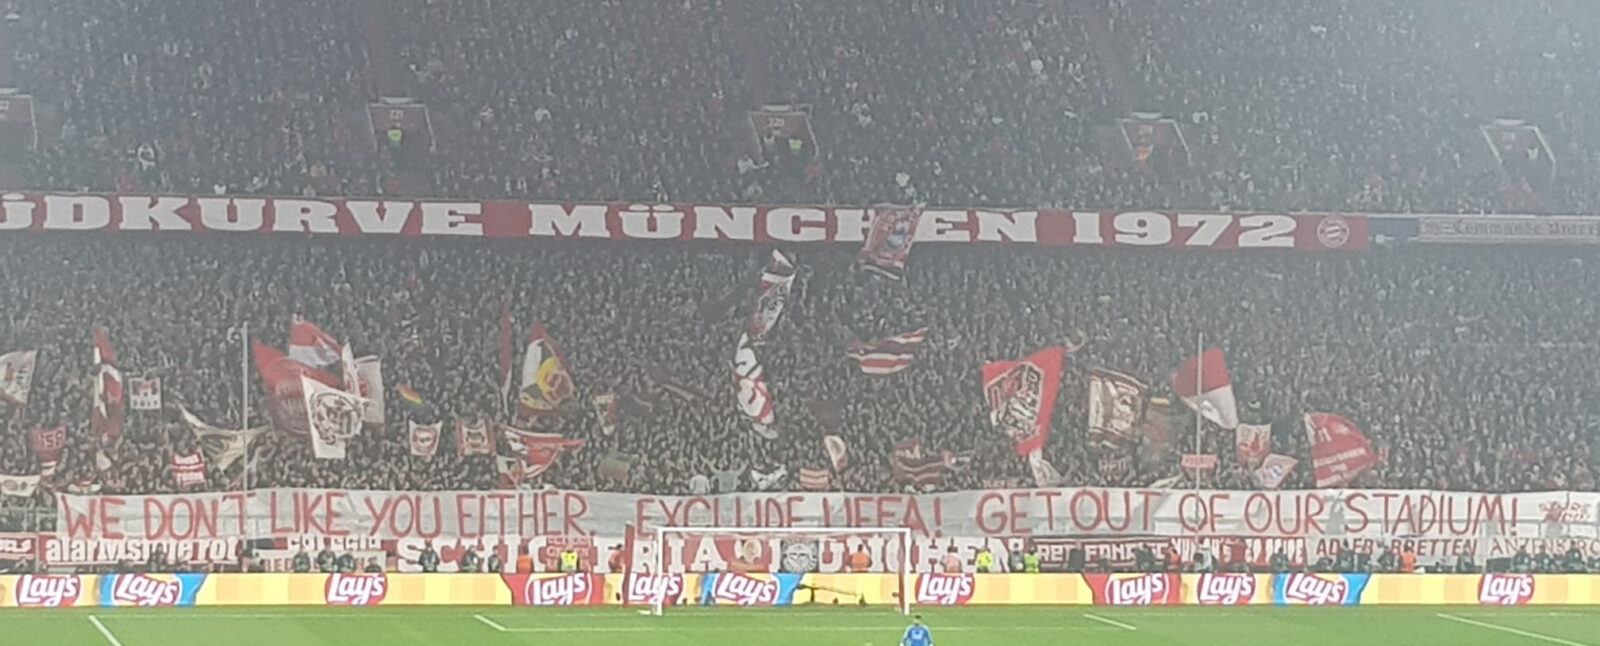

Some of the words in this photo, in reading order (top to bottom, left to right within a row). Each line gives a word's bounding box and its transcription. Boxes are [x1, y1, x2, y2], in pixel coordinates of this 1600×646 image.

[528, 203, 1038, 243] MÜNCHEN
[1072, 211, 1297, 247] 1972
[60, 493, 126, 540] WE
[143, 491, 256, 541] DON'T
[269, 490, 349, 536] LIKE
[364, 492, 443, 538] YOU
[636, 496, 805, 537] EXCLUDE
[822, 495, 943, 538] UEFA!
[975, 490, 1063, 535] GET
[1070, 489, 1166, 533] OUT
[1178, 492, 1231, 533] OF
[1244, 492, 1326, 536] OUR
[1344, 490, 1519, 537] STADIUM!
[397, 534, 728, 573] SCHICERIA
[1316, 538, 1374, 556] ADER
[1391, 538, 1478, 556] BRETTEN
